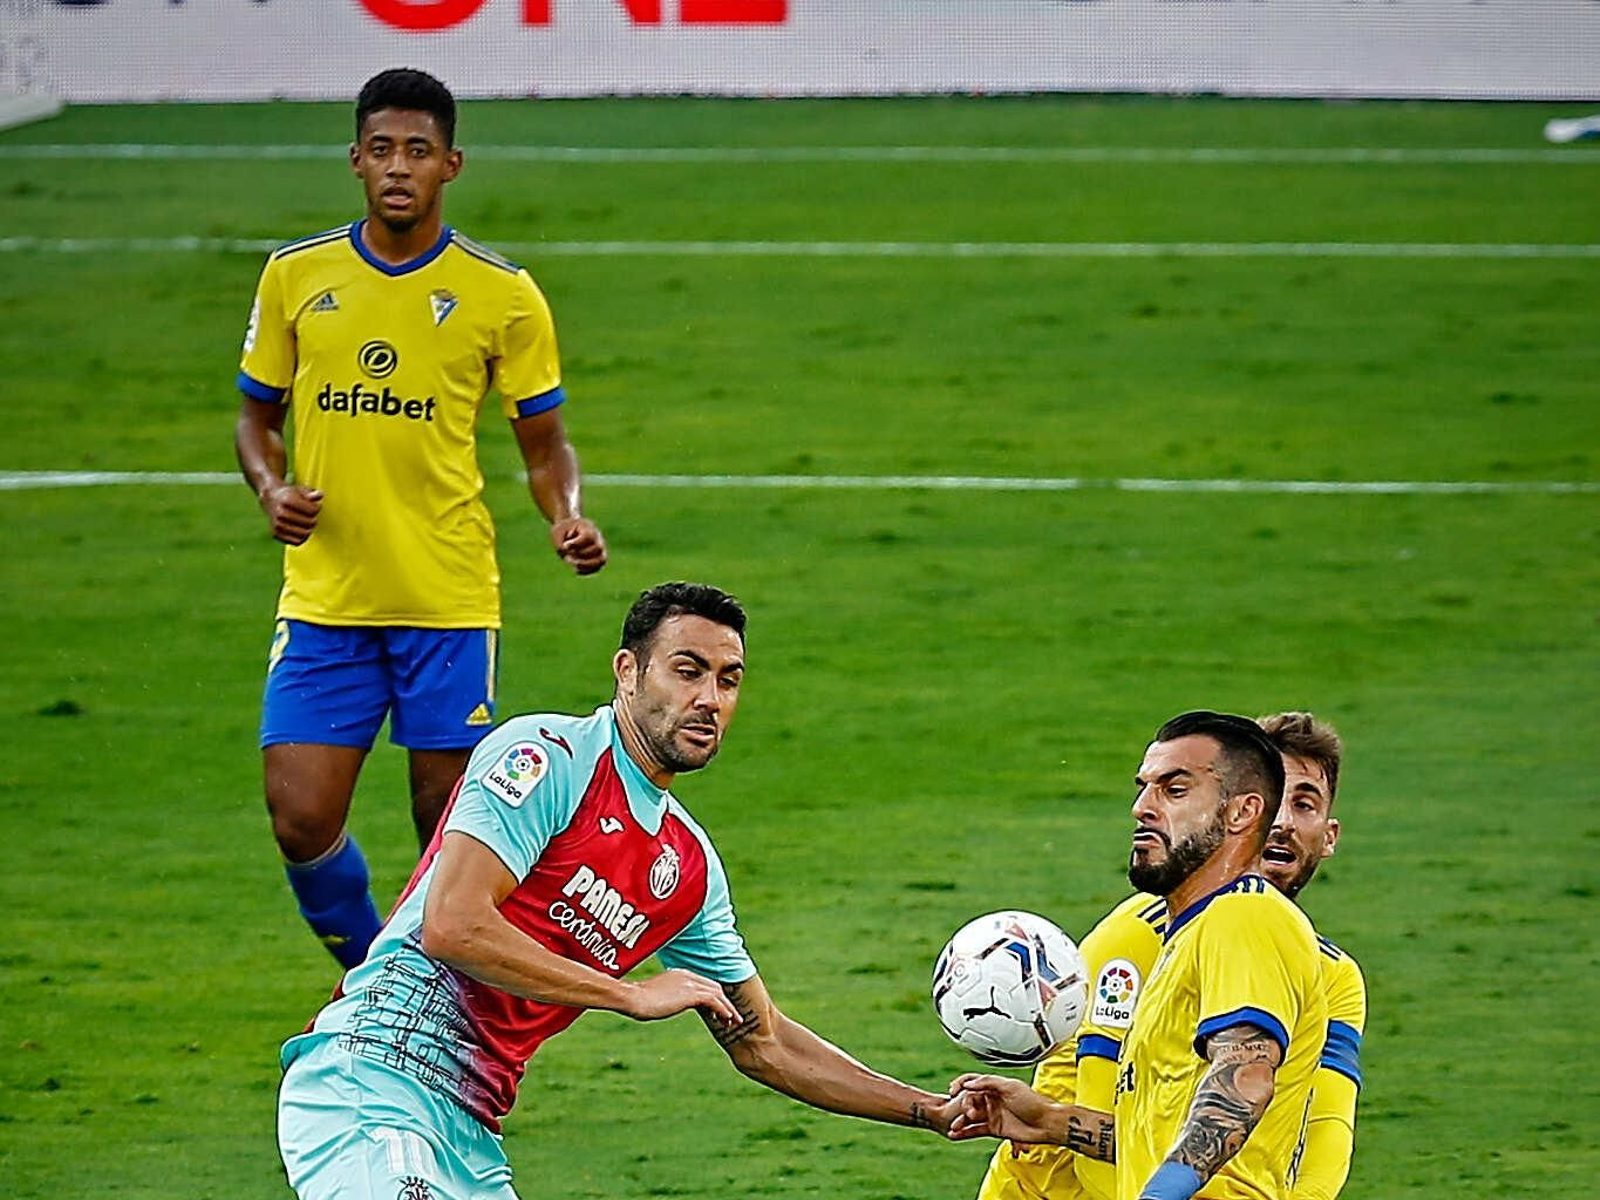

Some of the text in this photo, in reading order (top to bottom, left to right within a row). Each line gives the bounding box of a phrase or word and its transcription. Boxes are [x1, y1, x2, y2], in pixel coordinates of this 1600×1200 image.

[318, 383, 436, 422] dafabet
[489, 771, 522, 799] LaLiga
[562, 864, 650, 949] PAMESA
[1095, 1005, 1130, 1020] LaLiga
